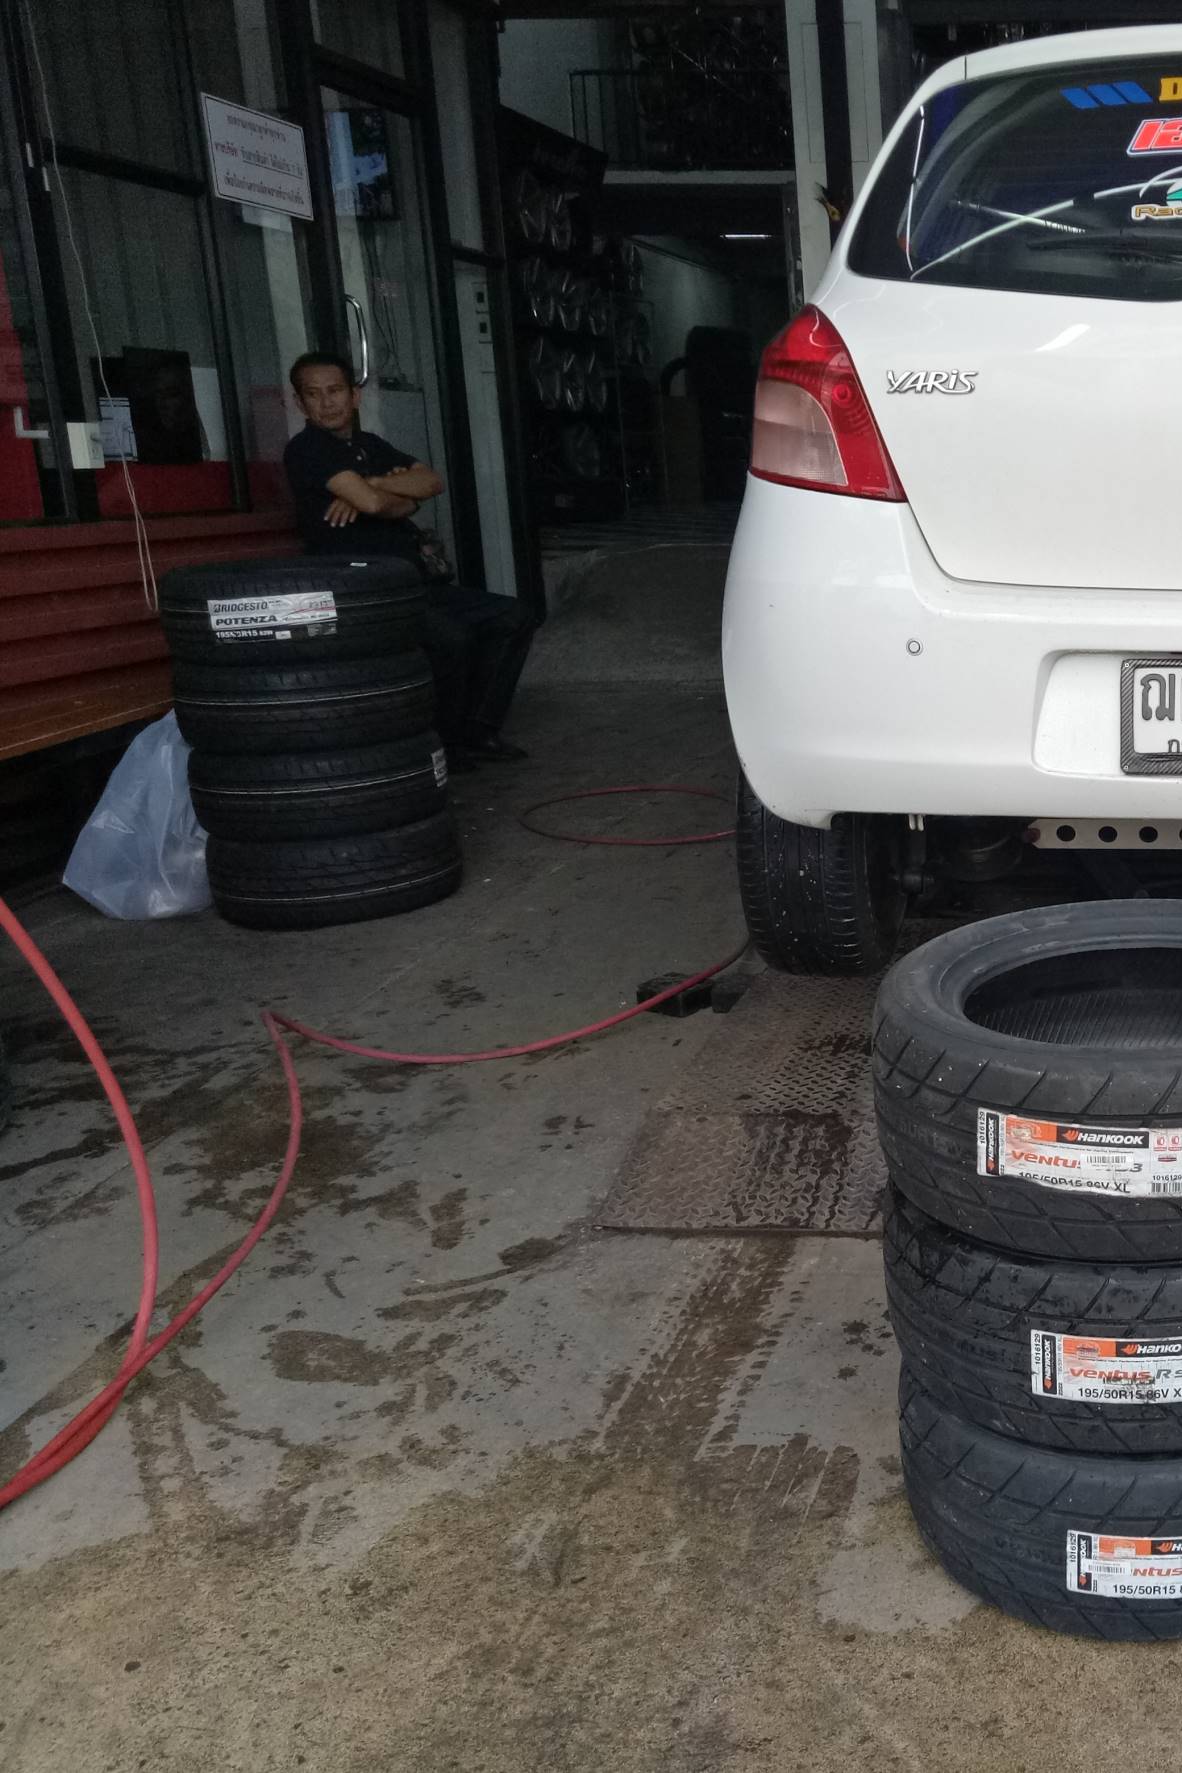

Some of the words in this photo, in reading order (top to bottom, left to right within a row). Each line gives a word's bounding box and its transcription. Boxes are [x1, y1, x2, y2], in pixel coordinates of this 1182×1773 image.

[215, 614, 278, 626] POTENZA
[1113, 1182, 1131, 1195] XL
[1112, 1584, 1176, 1595] 195/50R15
